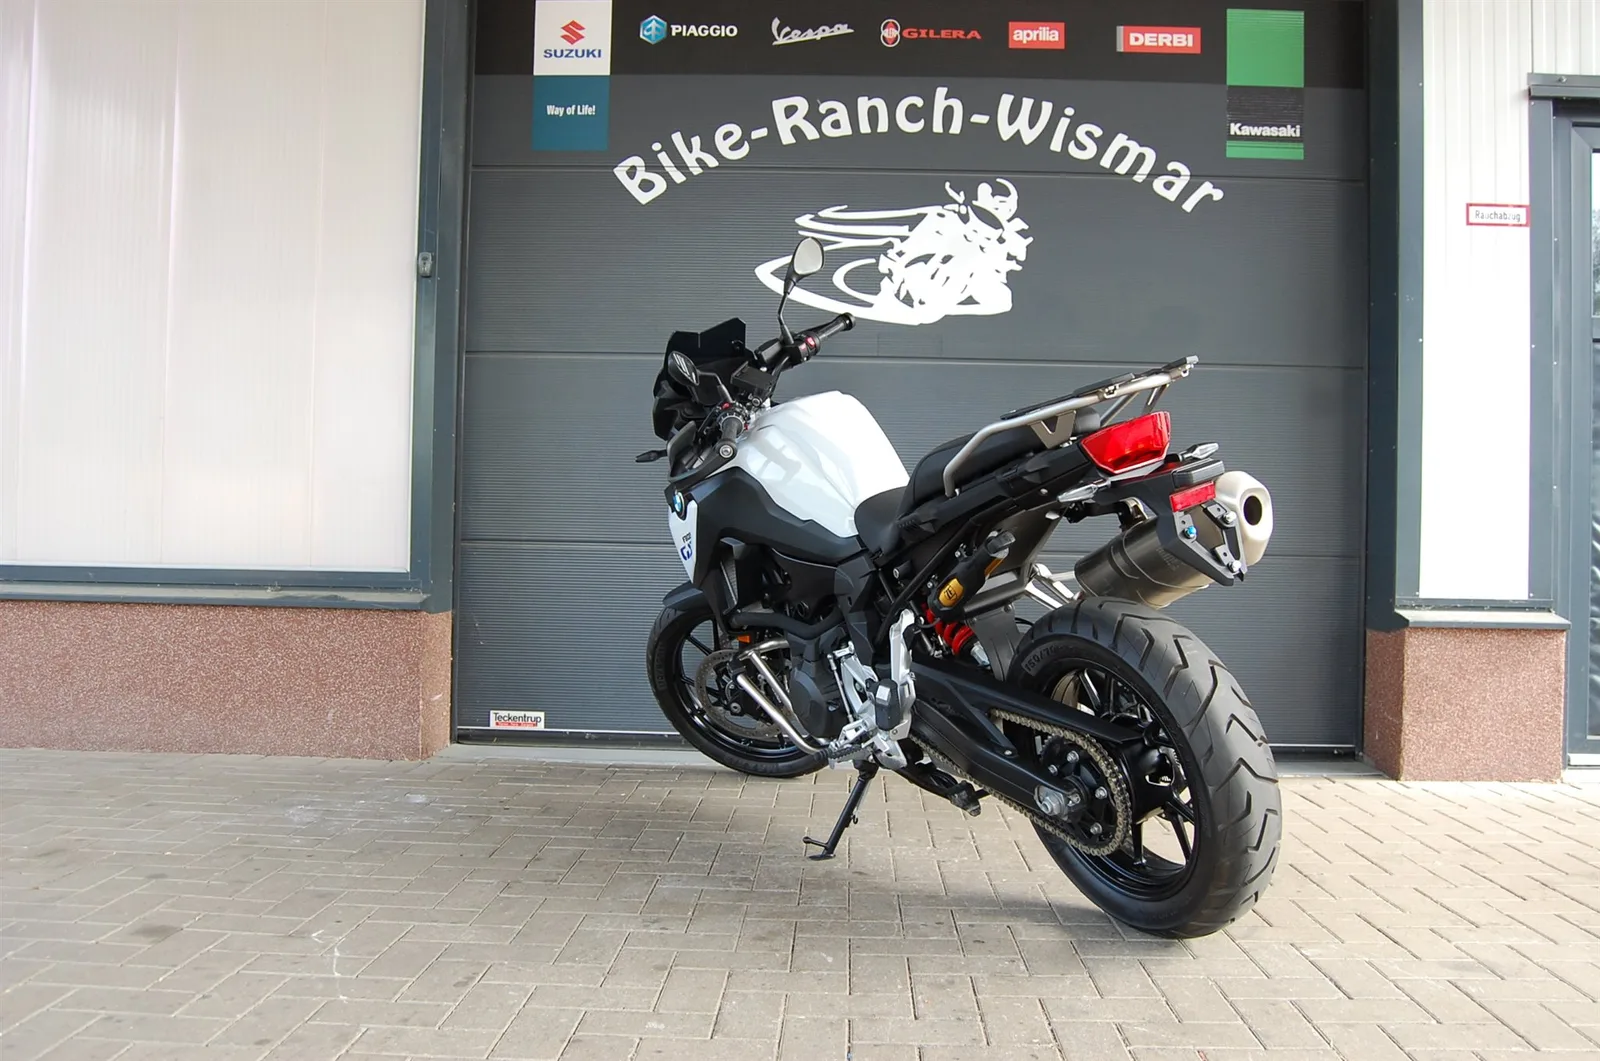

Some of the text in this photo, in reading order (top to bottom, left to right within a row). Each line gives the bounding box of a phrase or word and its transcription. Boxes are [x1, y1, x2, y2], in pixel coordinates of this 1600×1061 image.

[670, 24, 738, 37] PIAGGIO
[771, 16, 854, 46] Vespa
[902, 28, 982, 40] GILERA
[1013, 27, 1059, 44] aprilia
[1129, 32, 1193, 47] DERBI
[543, 48, 602, 59] SUZUKI
[546, 104, 596, 117] Way of Life!
[1229, 122, 1301, 138] Kawasaki
[1475, 209, 1521, 222] Rauchabzug
[493, 712, 542, 727] Teckentrup
